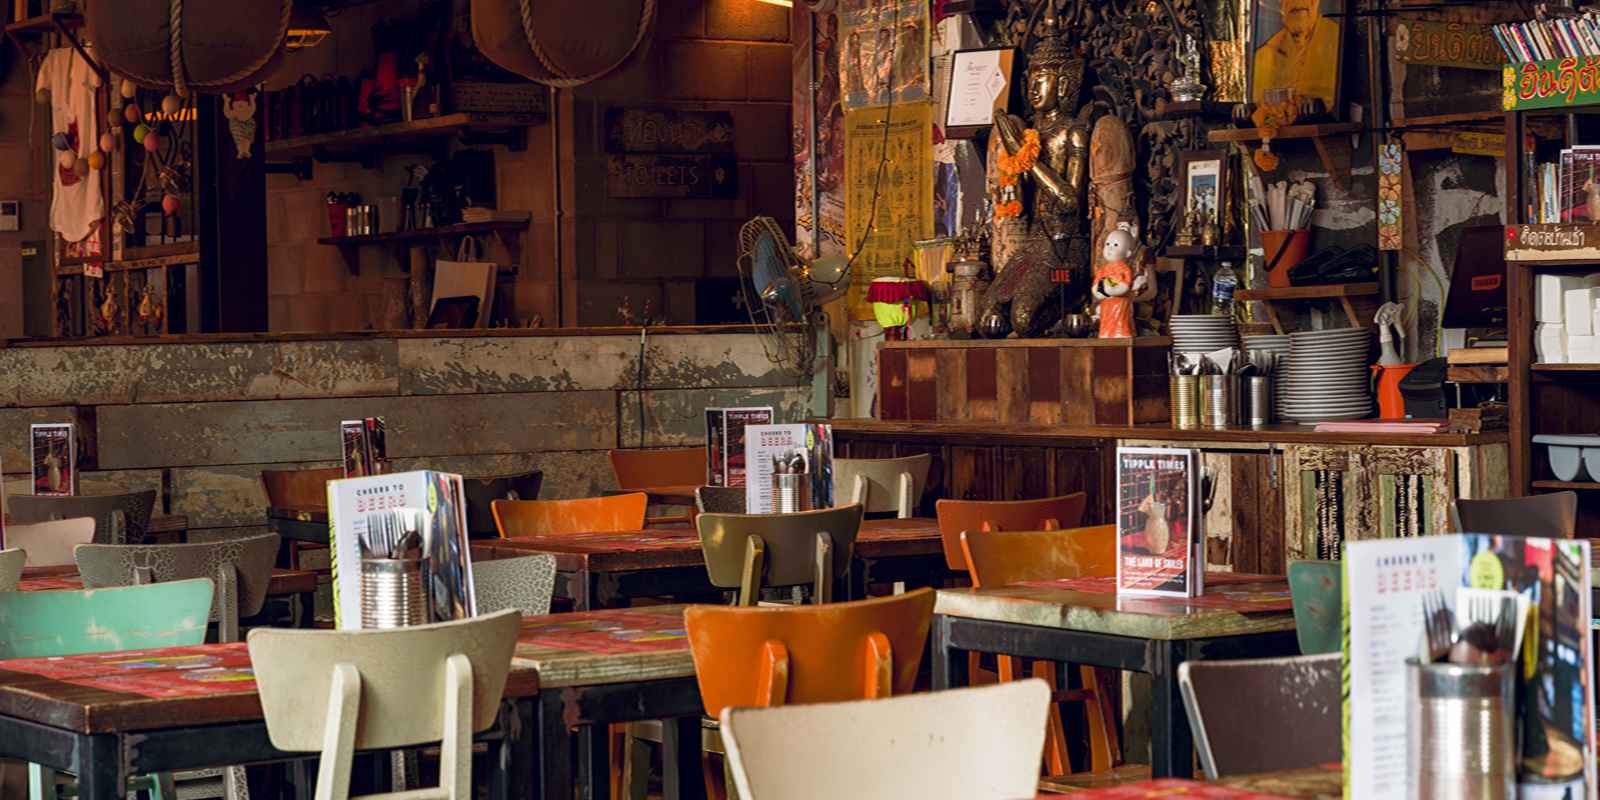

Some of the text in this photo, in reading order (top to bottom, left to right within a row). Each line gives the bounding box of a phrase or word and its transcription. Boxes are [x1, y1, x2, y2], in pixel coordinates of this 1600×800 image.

[1519, 56, 1600, 103] ยินดีต้
[1123, 458, 1185, 470] TIPPLE TIMES
[356, 486, 390, 496] CHEERS
[1123, 556, 1136, 567] THE
[1137, 557, 1153, 568] LAND
